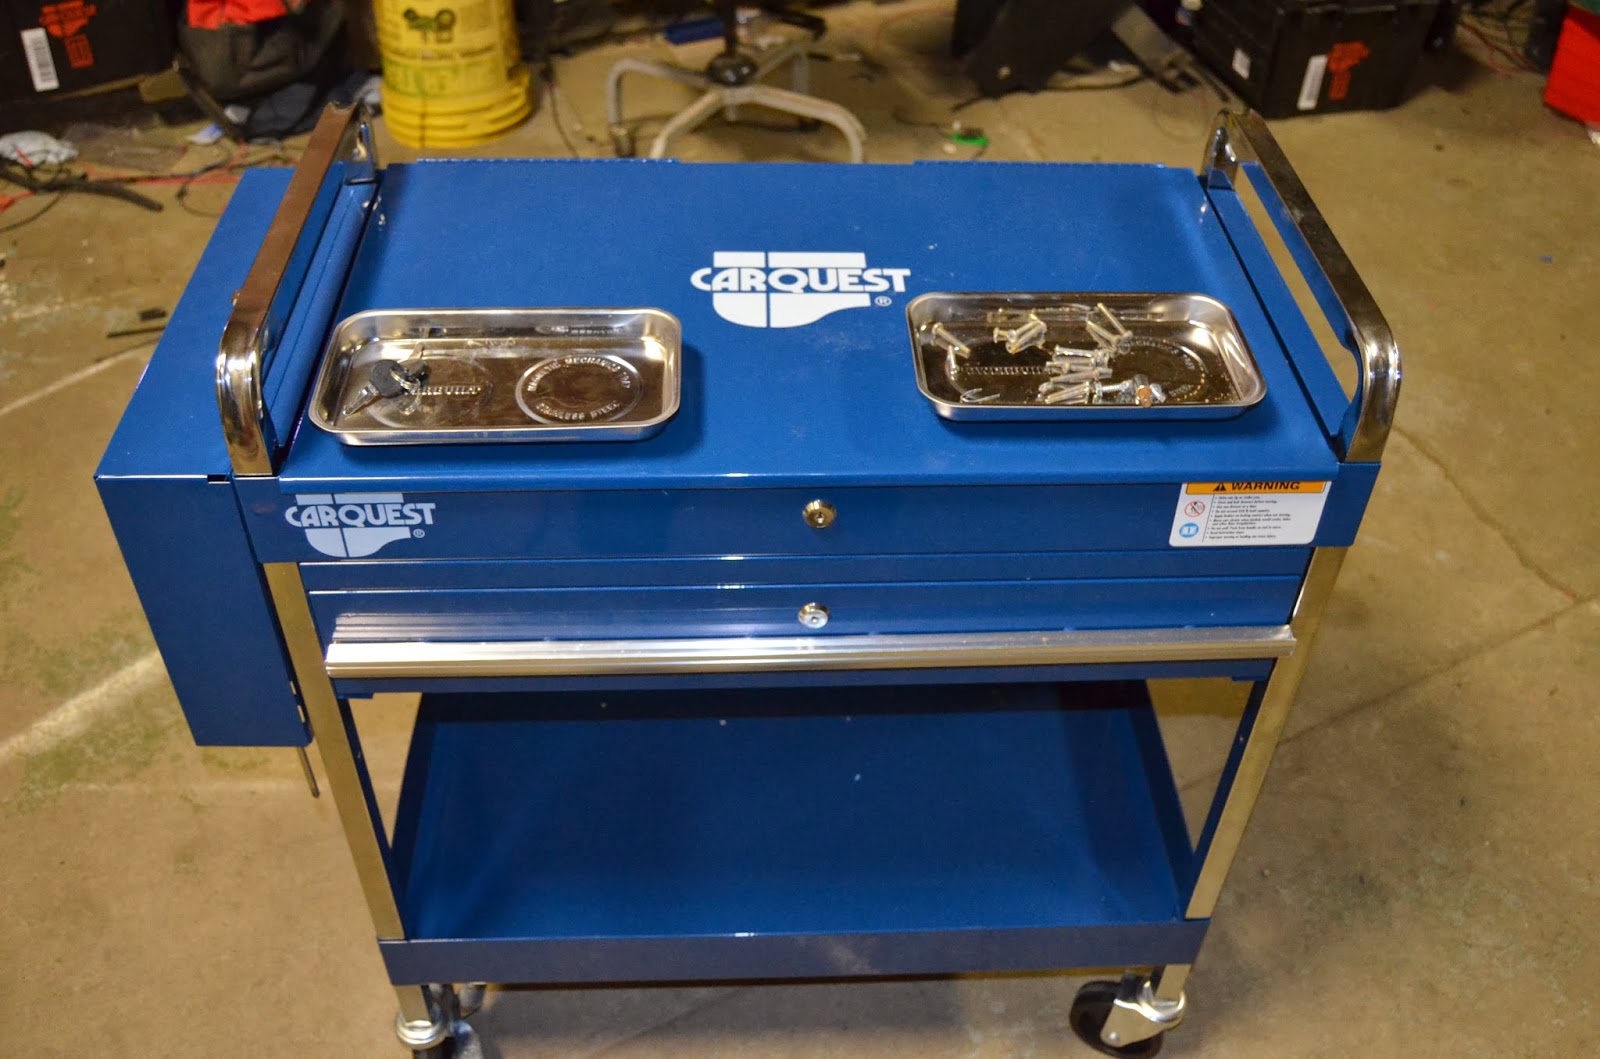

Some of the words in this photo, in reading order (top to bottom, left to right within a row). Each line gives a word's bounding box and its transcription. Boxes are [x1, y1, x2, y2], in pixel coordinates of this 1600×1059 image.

[690, 267, 911, 294] CARQUEST
[1230, 482, 1301, 491] WARNING
[284, 502, 436, 527] CARQUEST
